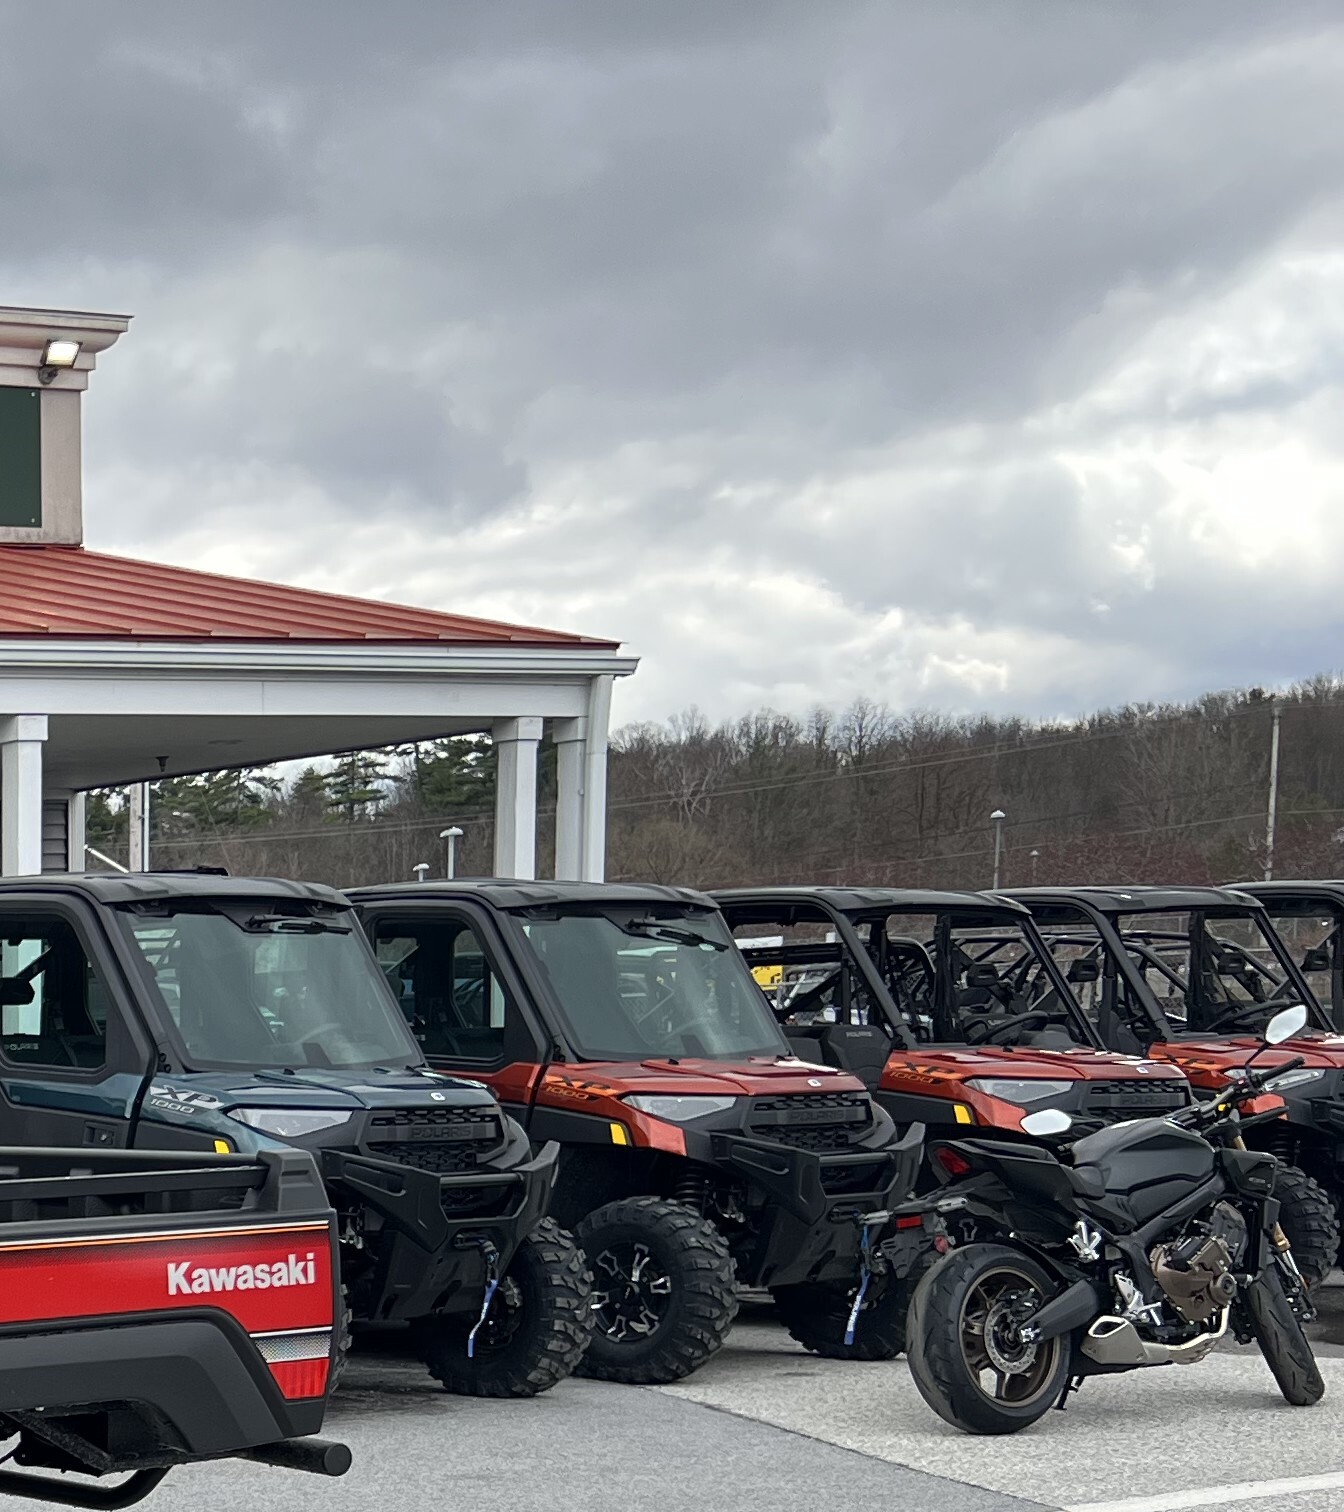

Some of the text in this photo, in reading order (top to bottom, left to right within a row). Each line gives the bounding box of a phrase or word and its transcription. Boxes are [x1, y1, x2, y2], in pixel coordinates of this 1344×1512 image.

[152, 1085, 218, 1104] XP
[545, 1085, 590, 1100] 1000
[151, 1098, 195, 1114] 1000
[412, 1125, 472, 1139] POLARIS
[167, 1252, 315, 1296] Kawasaki
